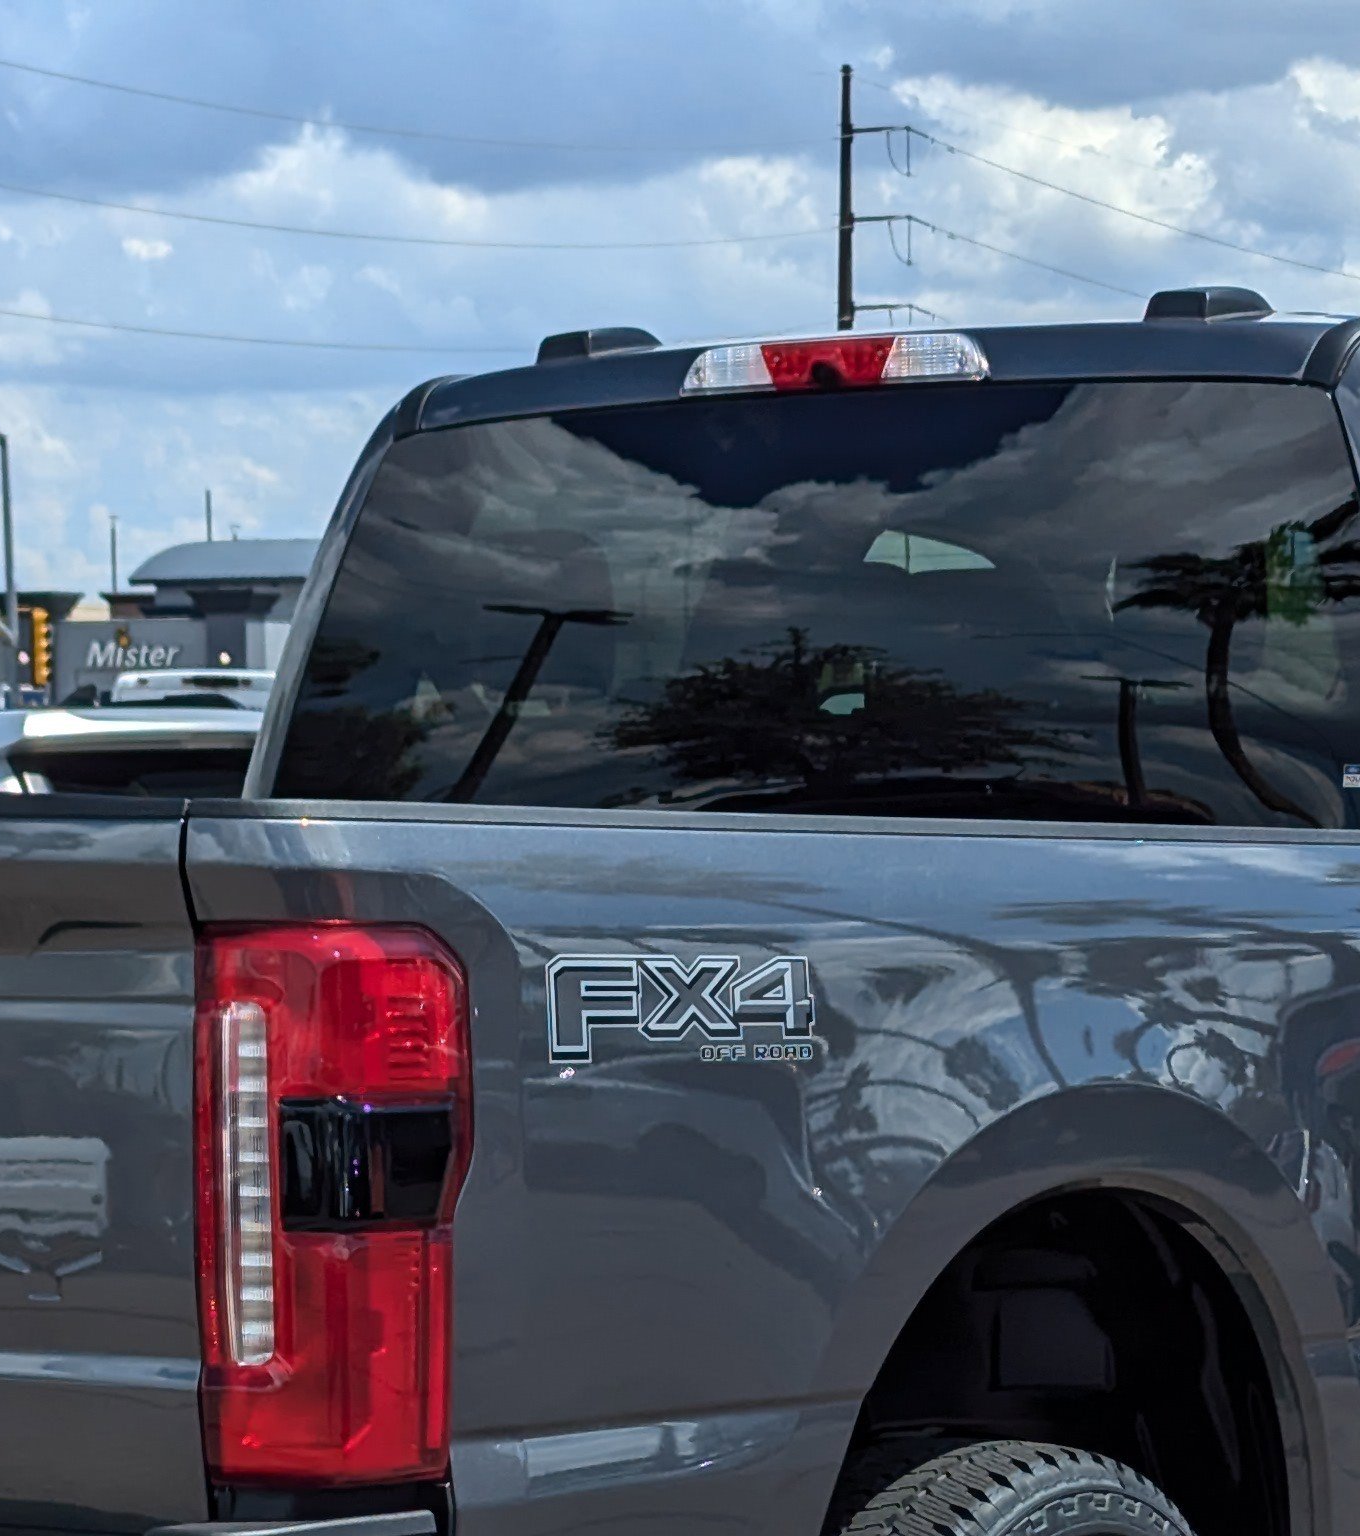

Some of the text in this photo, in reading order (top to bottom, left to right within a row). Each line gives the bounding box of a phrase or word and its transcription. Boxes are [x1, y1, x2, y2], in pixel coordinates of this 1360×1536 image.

[87, 640, 180, 668] Mister
[545, 953, 817, 1064] FX4
[699, 1044, 814, 1062] OFF ROAD
